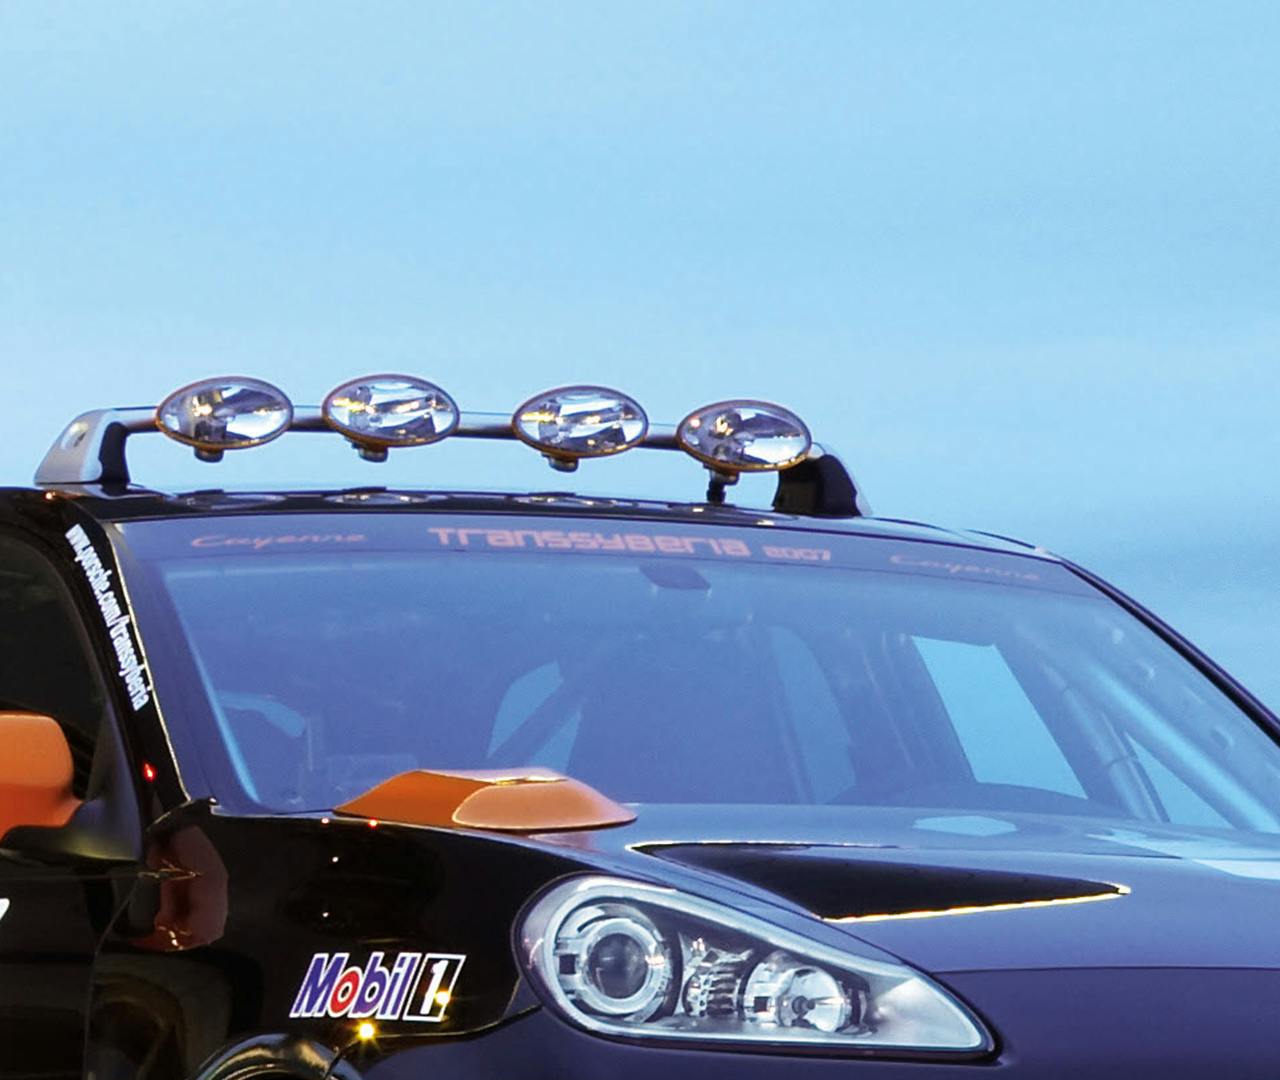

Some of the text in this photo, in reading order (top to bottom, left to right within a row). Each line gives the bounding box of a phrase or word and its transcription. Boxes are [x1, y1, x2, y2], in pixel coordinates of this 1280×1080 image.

[191, 533, 367, 549] Cayenne
[762, 546, 832, 561] 2007
[289, 952, 422, 1020] Mobil
